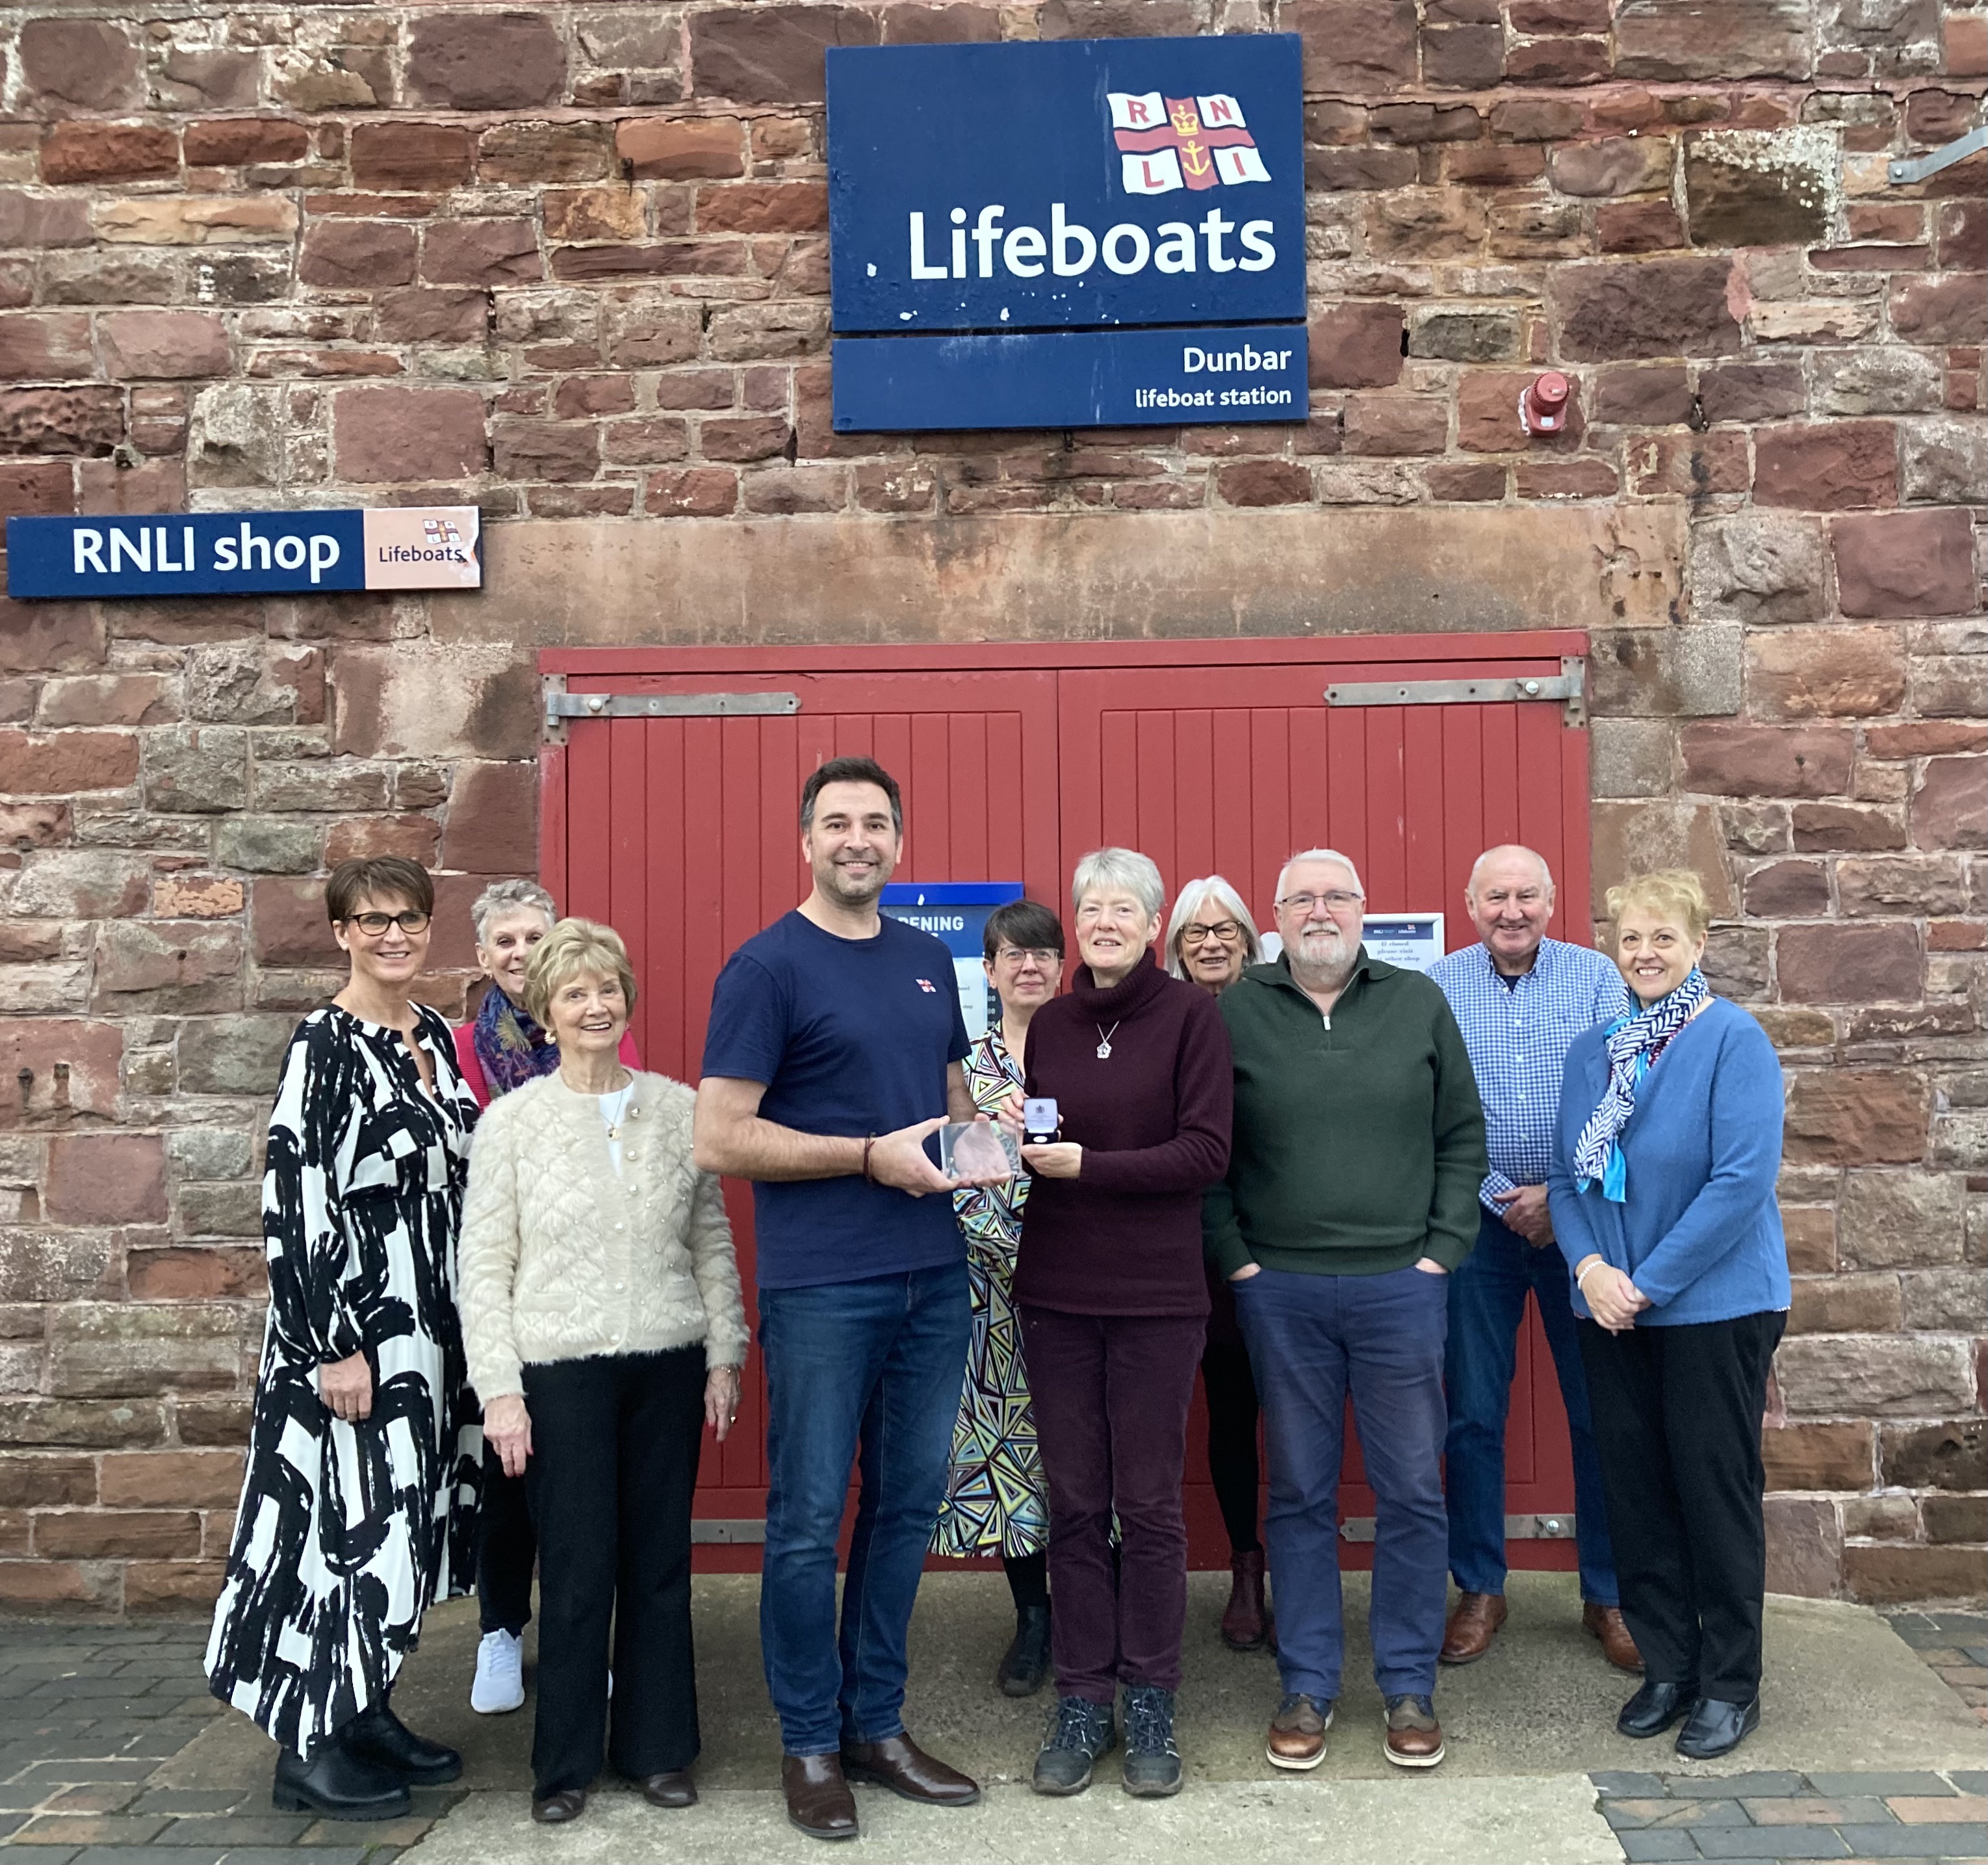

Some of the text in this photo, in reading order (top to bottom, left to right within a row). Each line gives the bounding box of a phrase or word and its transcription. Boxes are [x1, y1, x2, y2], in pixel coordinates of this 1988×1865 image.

[1126, 99, 1233, 124] R N
[1141, 152, 1247, 188] L I
[910, 203, 1276, 280] Lifeboats
[1183, 344, 1292, 373] Dunbar
[1135, 385, 1292, 408] lifeboat station
[73, 521, 340, 584] RNLI shop
[380, 545, 463, 562] Lifeboats
[897, 916, 964, 931] ENING
